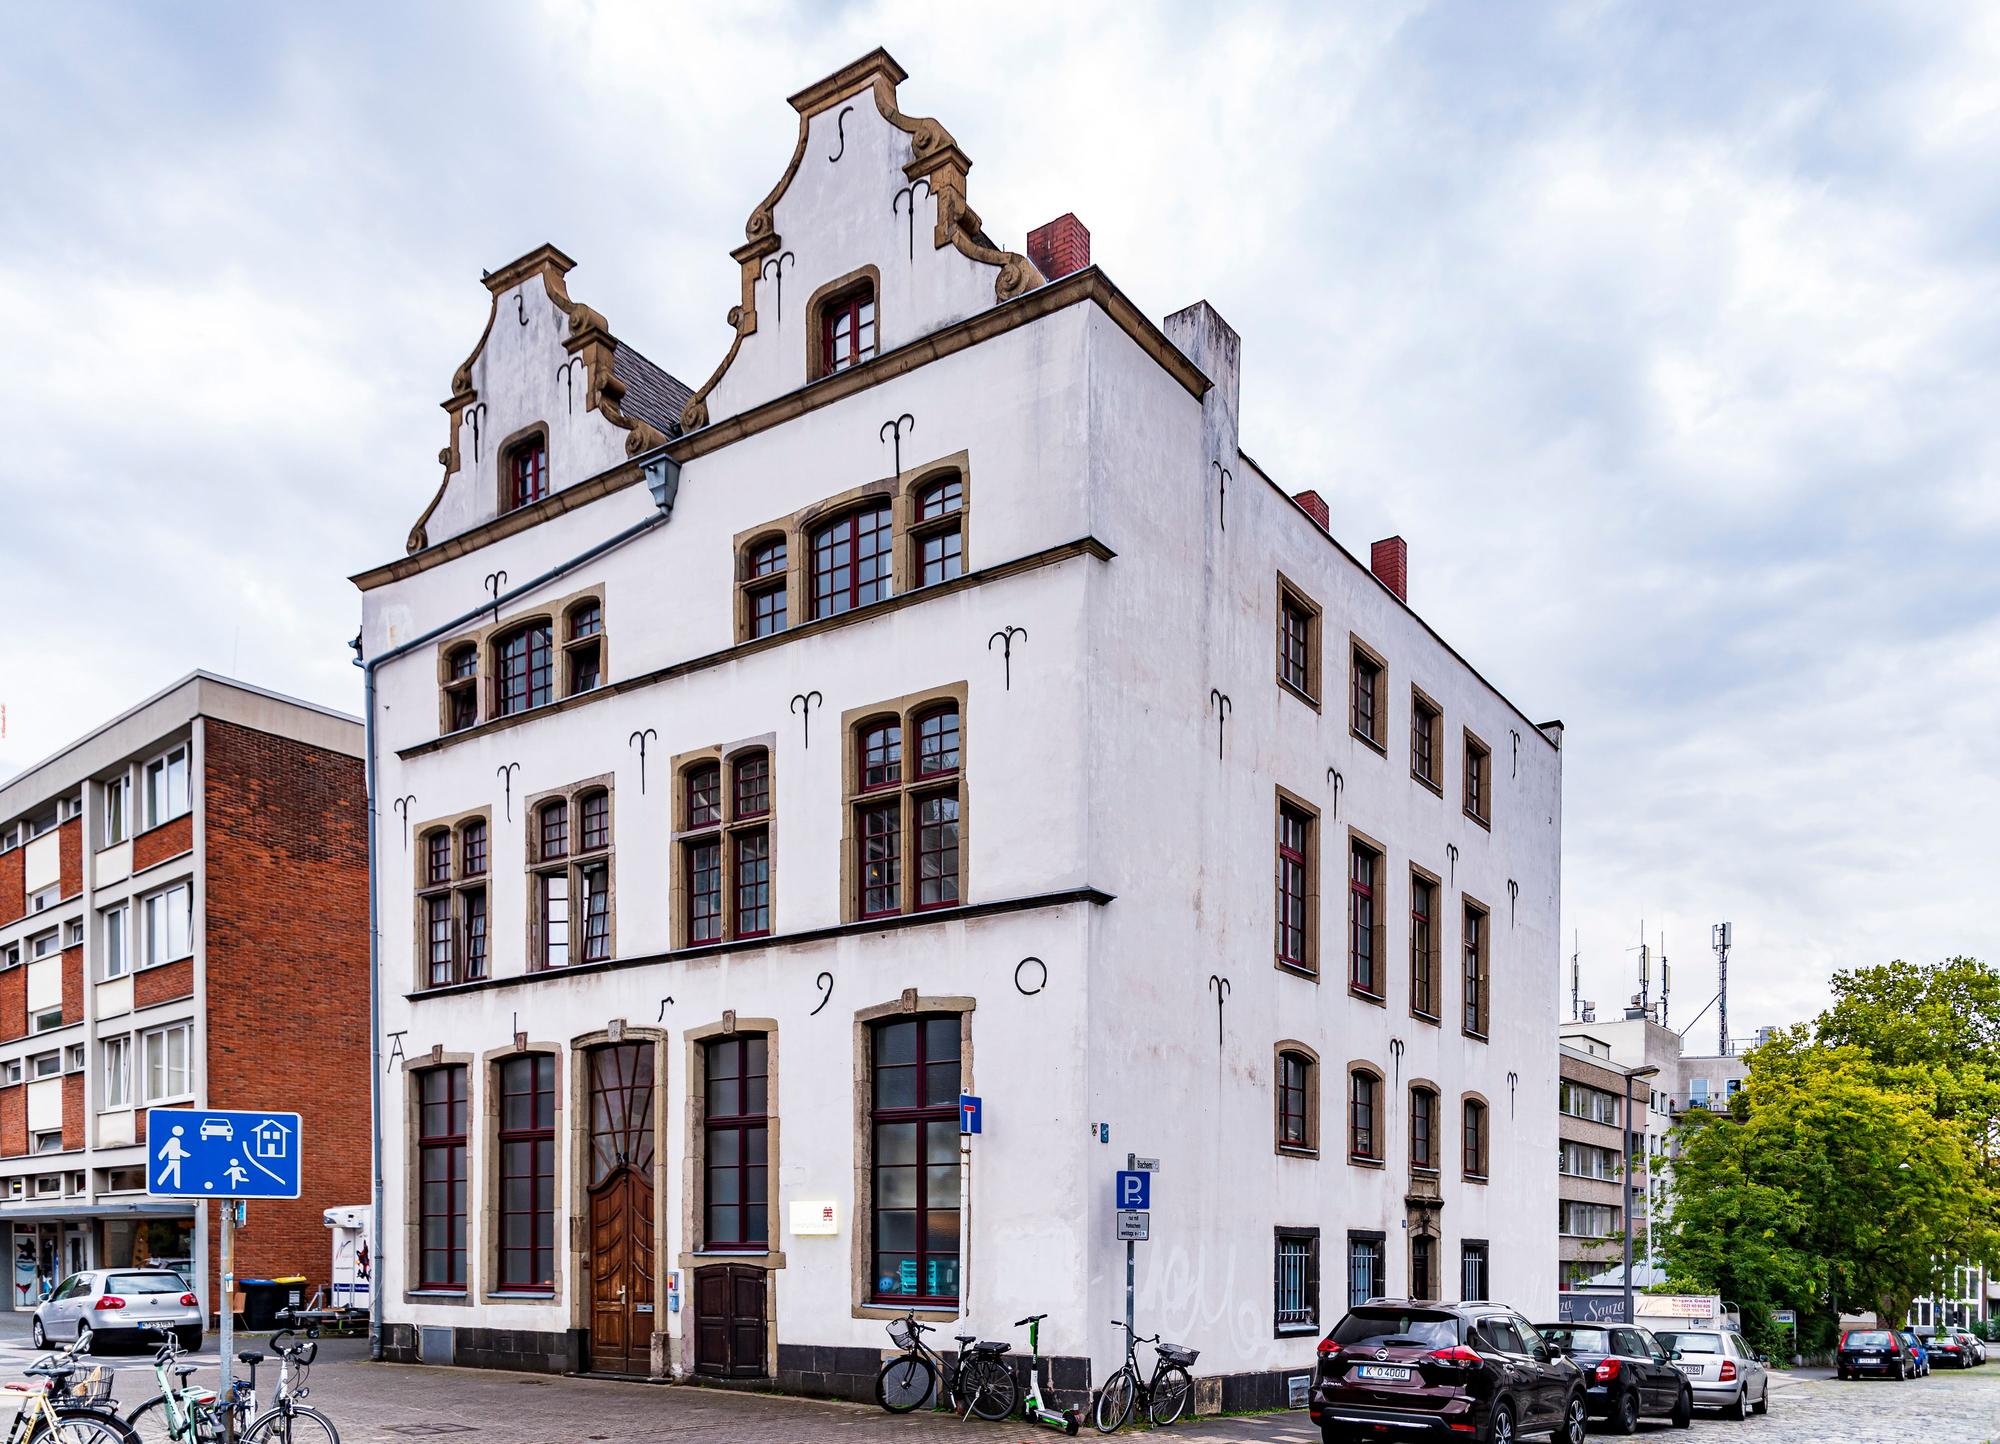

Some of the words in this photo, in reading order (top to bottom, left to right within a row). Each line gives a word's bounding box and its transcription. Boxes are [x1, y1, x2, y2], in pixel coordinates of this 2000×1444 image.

[1124, 1176, 1142, 1205] P
[1584, 1300, 1625, 1322] Sauza
[1366, 1366, 1373, 1376] K
[1384, 1368, 1406, 1378] 4000
